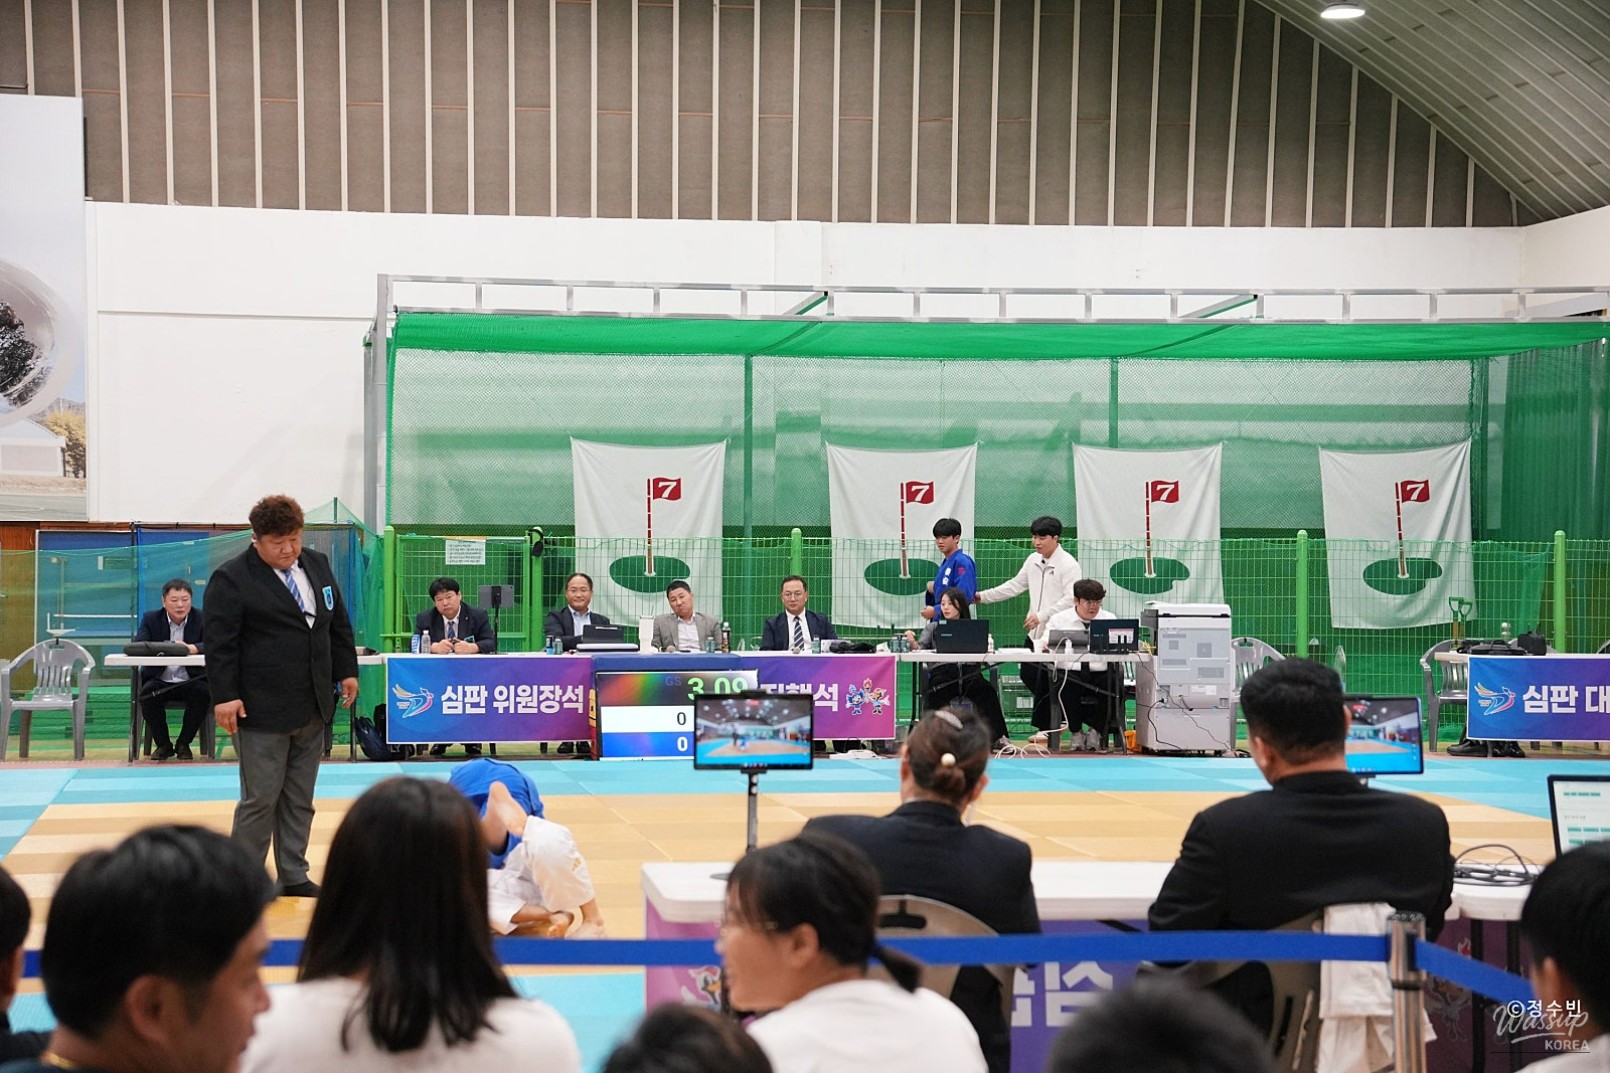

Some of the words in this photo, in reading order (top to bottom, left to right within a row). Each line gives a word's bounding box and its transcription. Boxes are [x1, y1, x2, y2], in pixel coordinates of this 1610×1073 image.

[658, 481, 677, 498] 7
[911, 485, 930, 501] 7
[1156, 484, 1175, 500] 7
[1406, 483, 1425, 500] 7
[665, 676, 682, 686] GS
[441, 685, 488, 714] 심판
[493, 685, 584, 714] 위원장석
[1523, 685, 1579, 714] 심판
[677, 712, 686, 726] 0
[677, 736, 688, 752] 0
